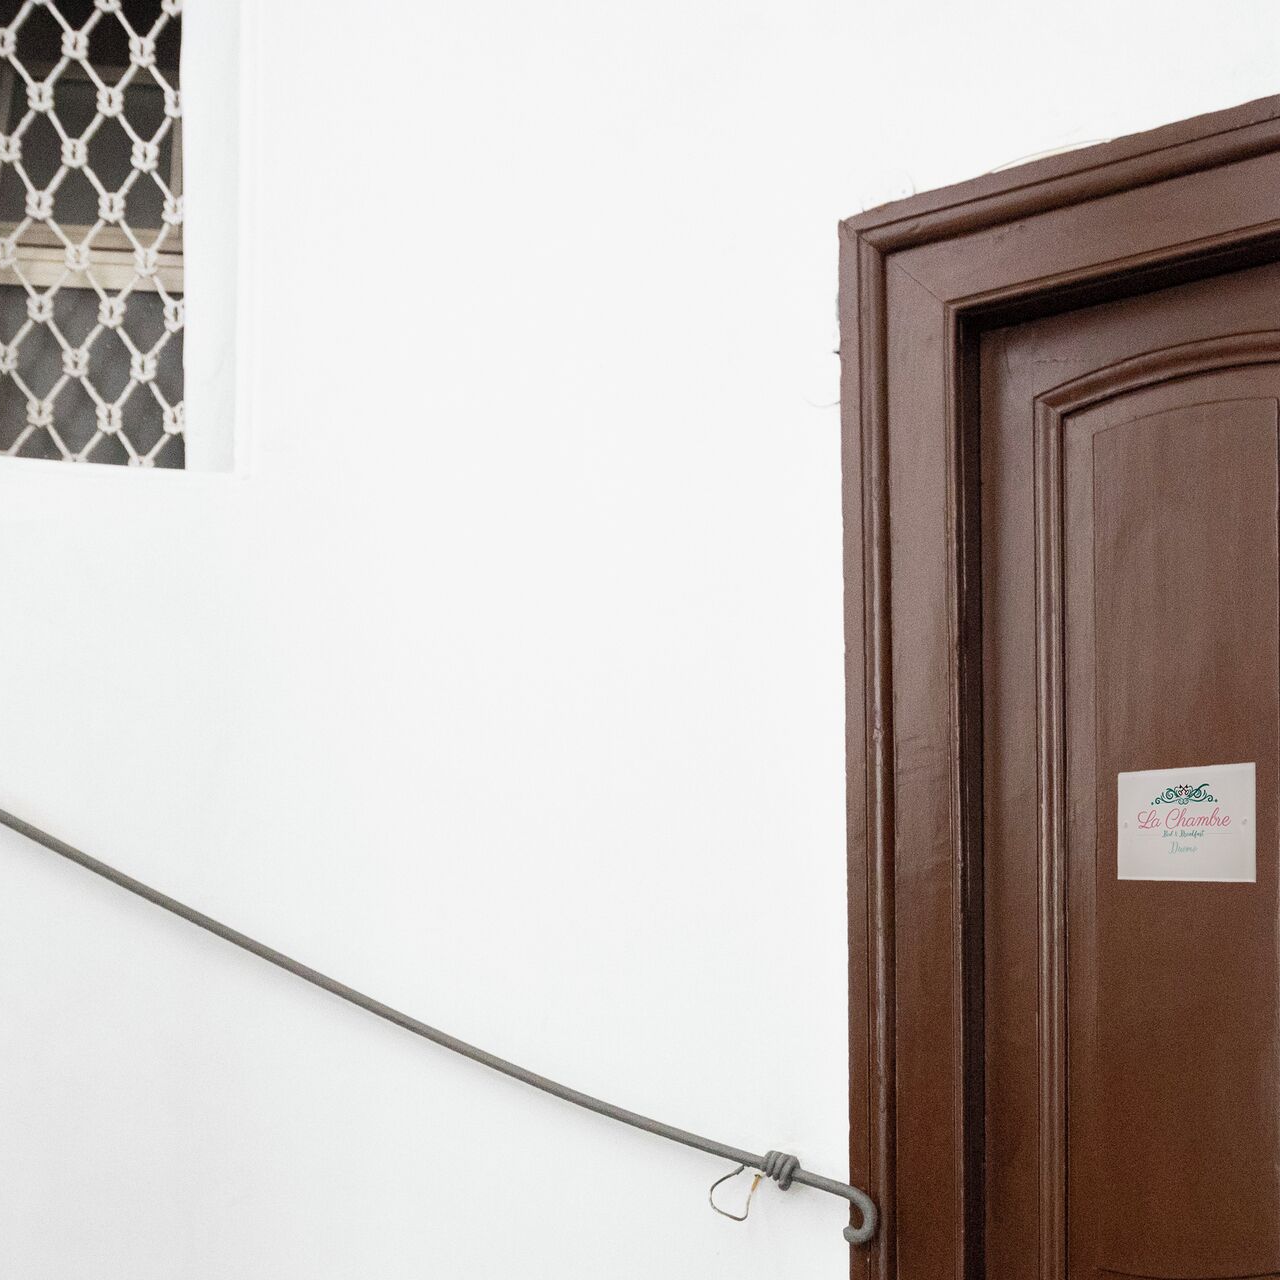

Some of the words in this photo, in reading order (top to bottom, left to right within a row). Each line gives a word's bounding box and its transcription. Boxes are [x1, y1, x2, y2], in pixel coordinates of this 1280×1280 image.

[1137, 809, 1162, 829] La
[1165, 807, 1232, 830] Chambre
[1180, 830, 1205, 839] Breakfast
